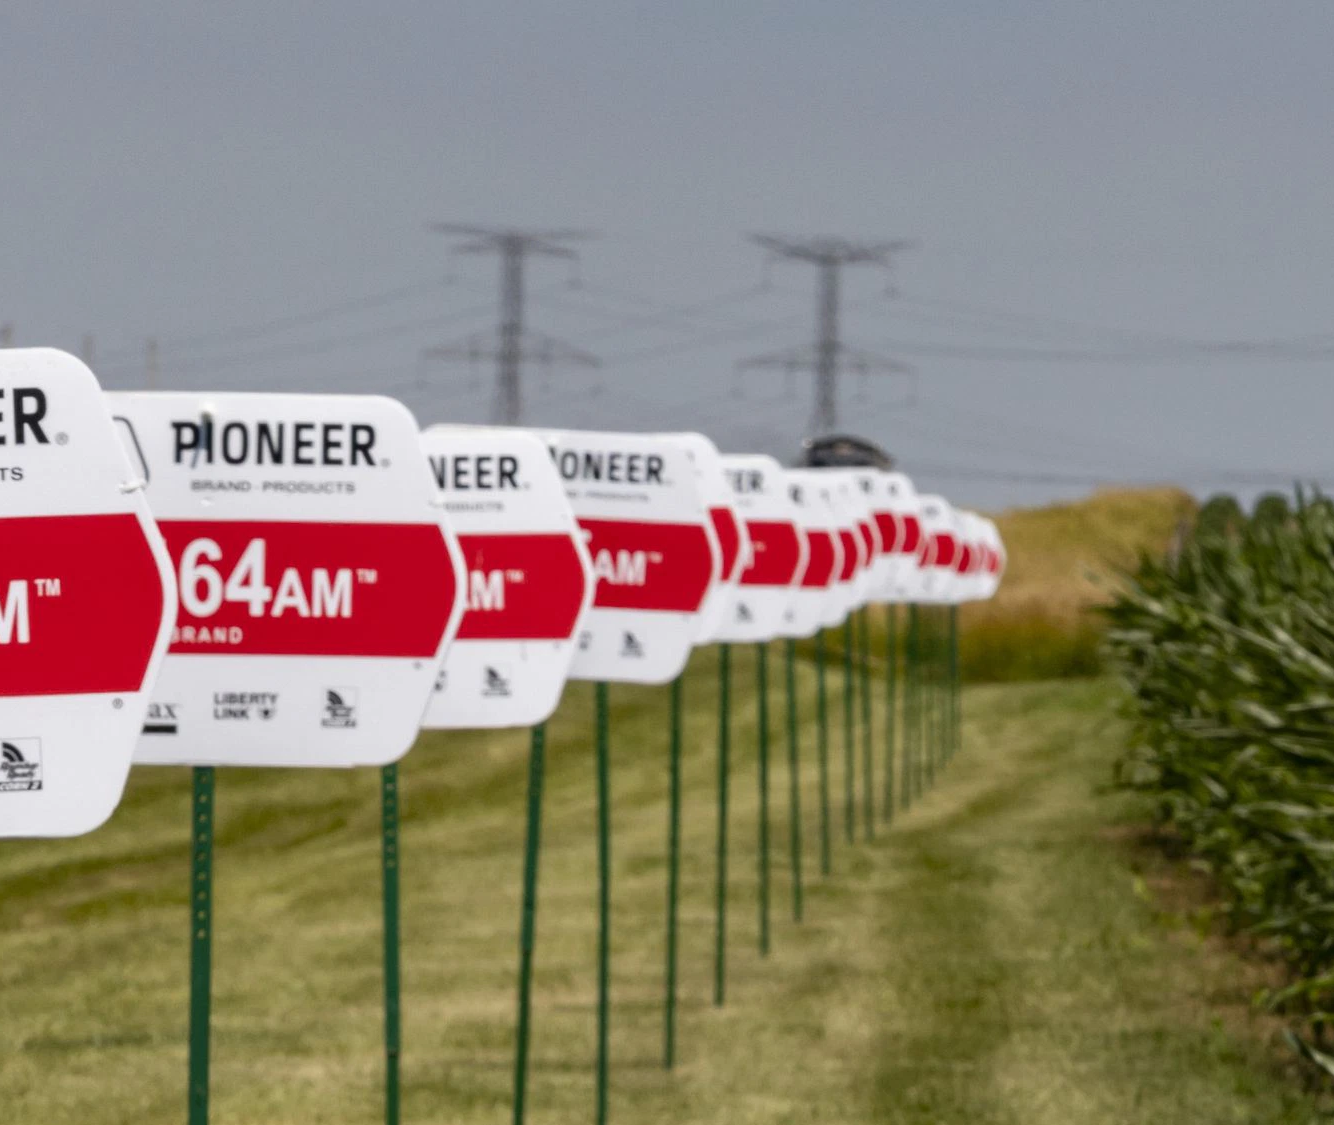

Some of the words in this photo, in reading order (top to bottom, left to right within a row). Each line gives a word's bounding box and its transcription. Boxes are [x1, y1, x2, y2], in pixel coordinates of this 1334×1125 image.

[190, 480, 251, 492] BRAND
[261, 480, 356, 494] PRODUCTS
[213, 692, 278, 705] LIBERTY
[213, 707, 249, 720] LINK
